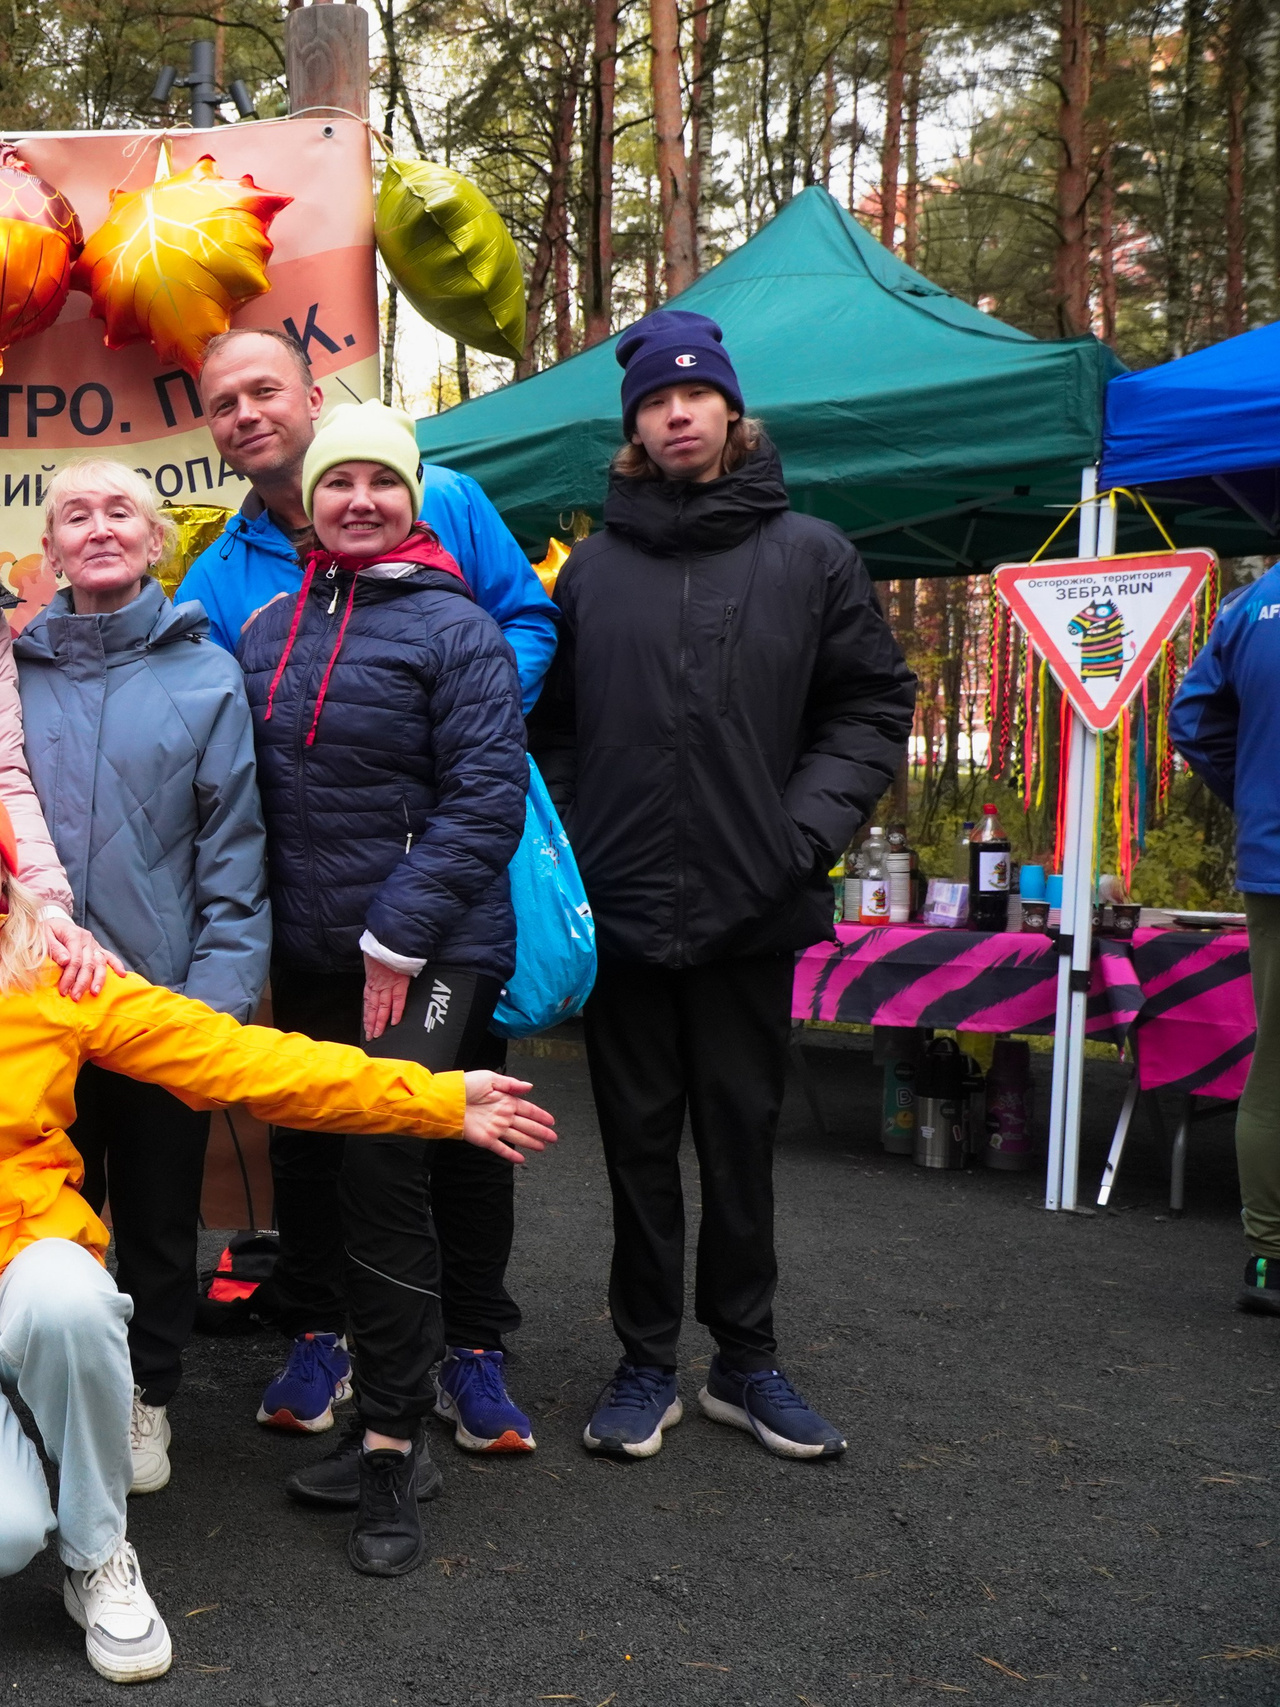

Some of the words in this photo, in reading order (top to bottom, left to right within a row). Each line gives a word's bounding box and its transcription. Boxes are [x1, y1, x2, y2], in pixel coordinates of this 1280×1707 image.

[1028, 577, 1096, 589] Осторожно,
[1103, 570, 1172, 583] территория
[1056, 585, 1113, 600] ЗЕБРА
[1118, 582, 1153, 596] RUN
[1258, 603, 1280, 621] AF
